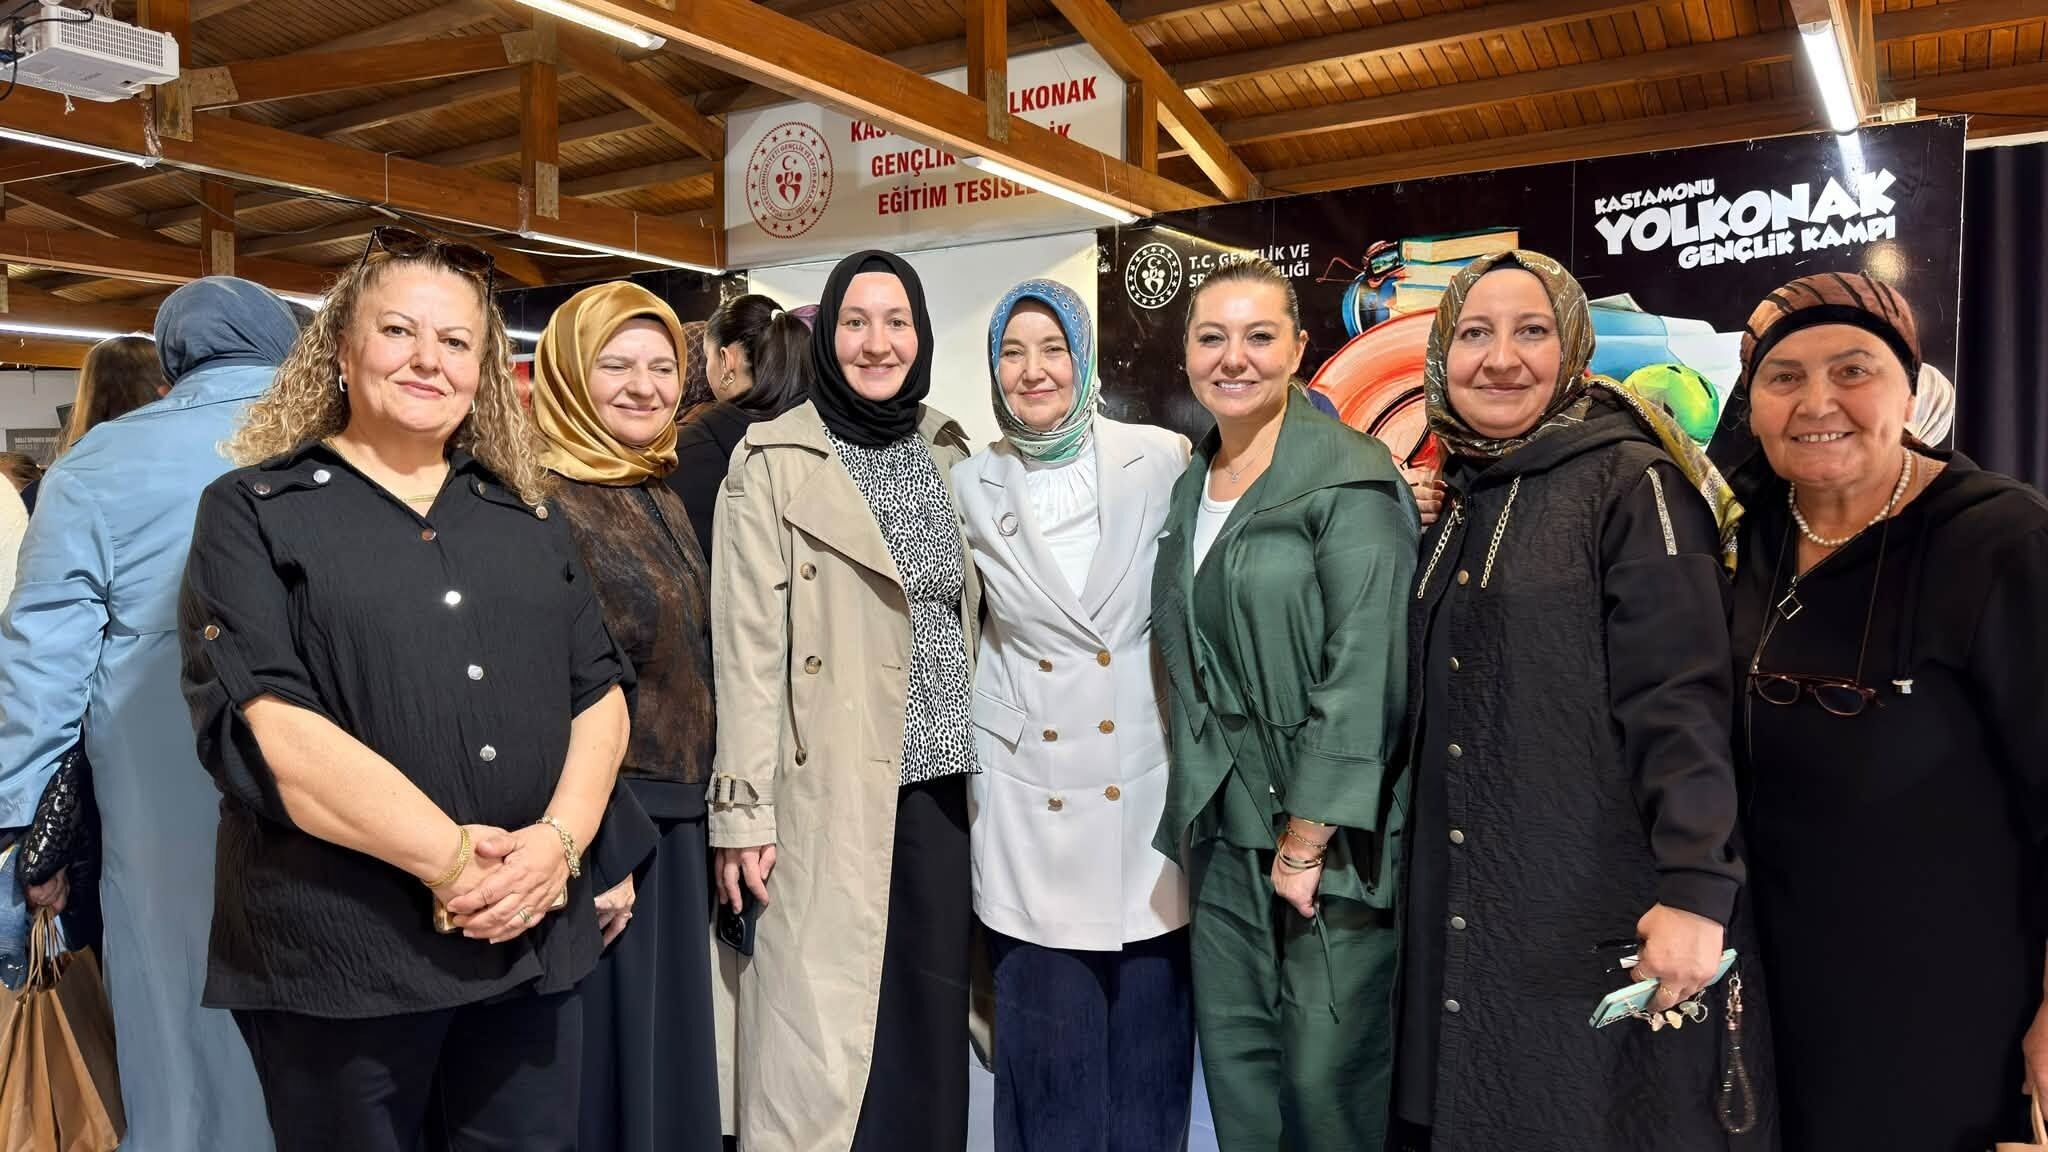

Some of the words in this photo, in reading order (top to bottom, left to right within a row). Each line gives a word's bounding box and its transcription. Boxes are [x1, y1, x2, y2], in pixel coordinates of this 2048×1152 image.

[1009, 76, 1097, 114] LKONAK
[878, 182, 947, 216] EĞİTİM
[1594, 179, 1716, 215] KASTAMONU
[1594, 167, 1897, 255] YOLKONAK
[1188, 255, 1215, 270] T.C.
[1289, 243, 1310, 259] VE
[1678, 232, 1795, 269] GENÇLİK
[1801, 215, 1896, 252] KAMPI
[1188, 273, 1206, 288] SP
